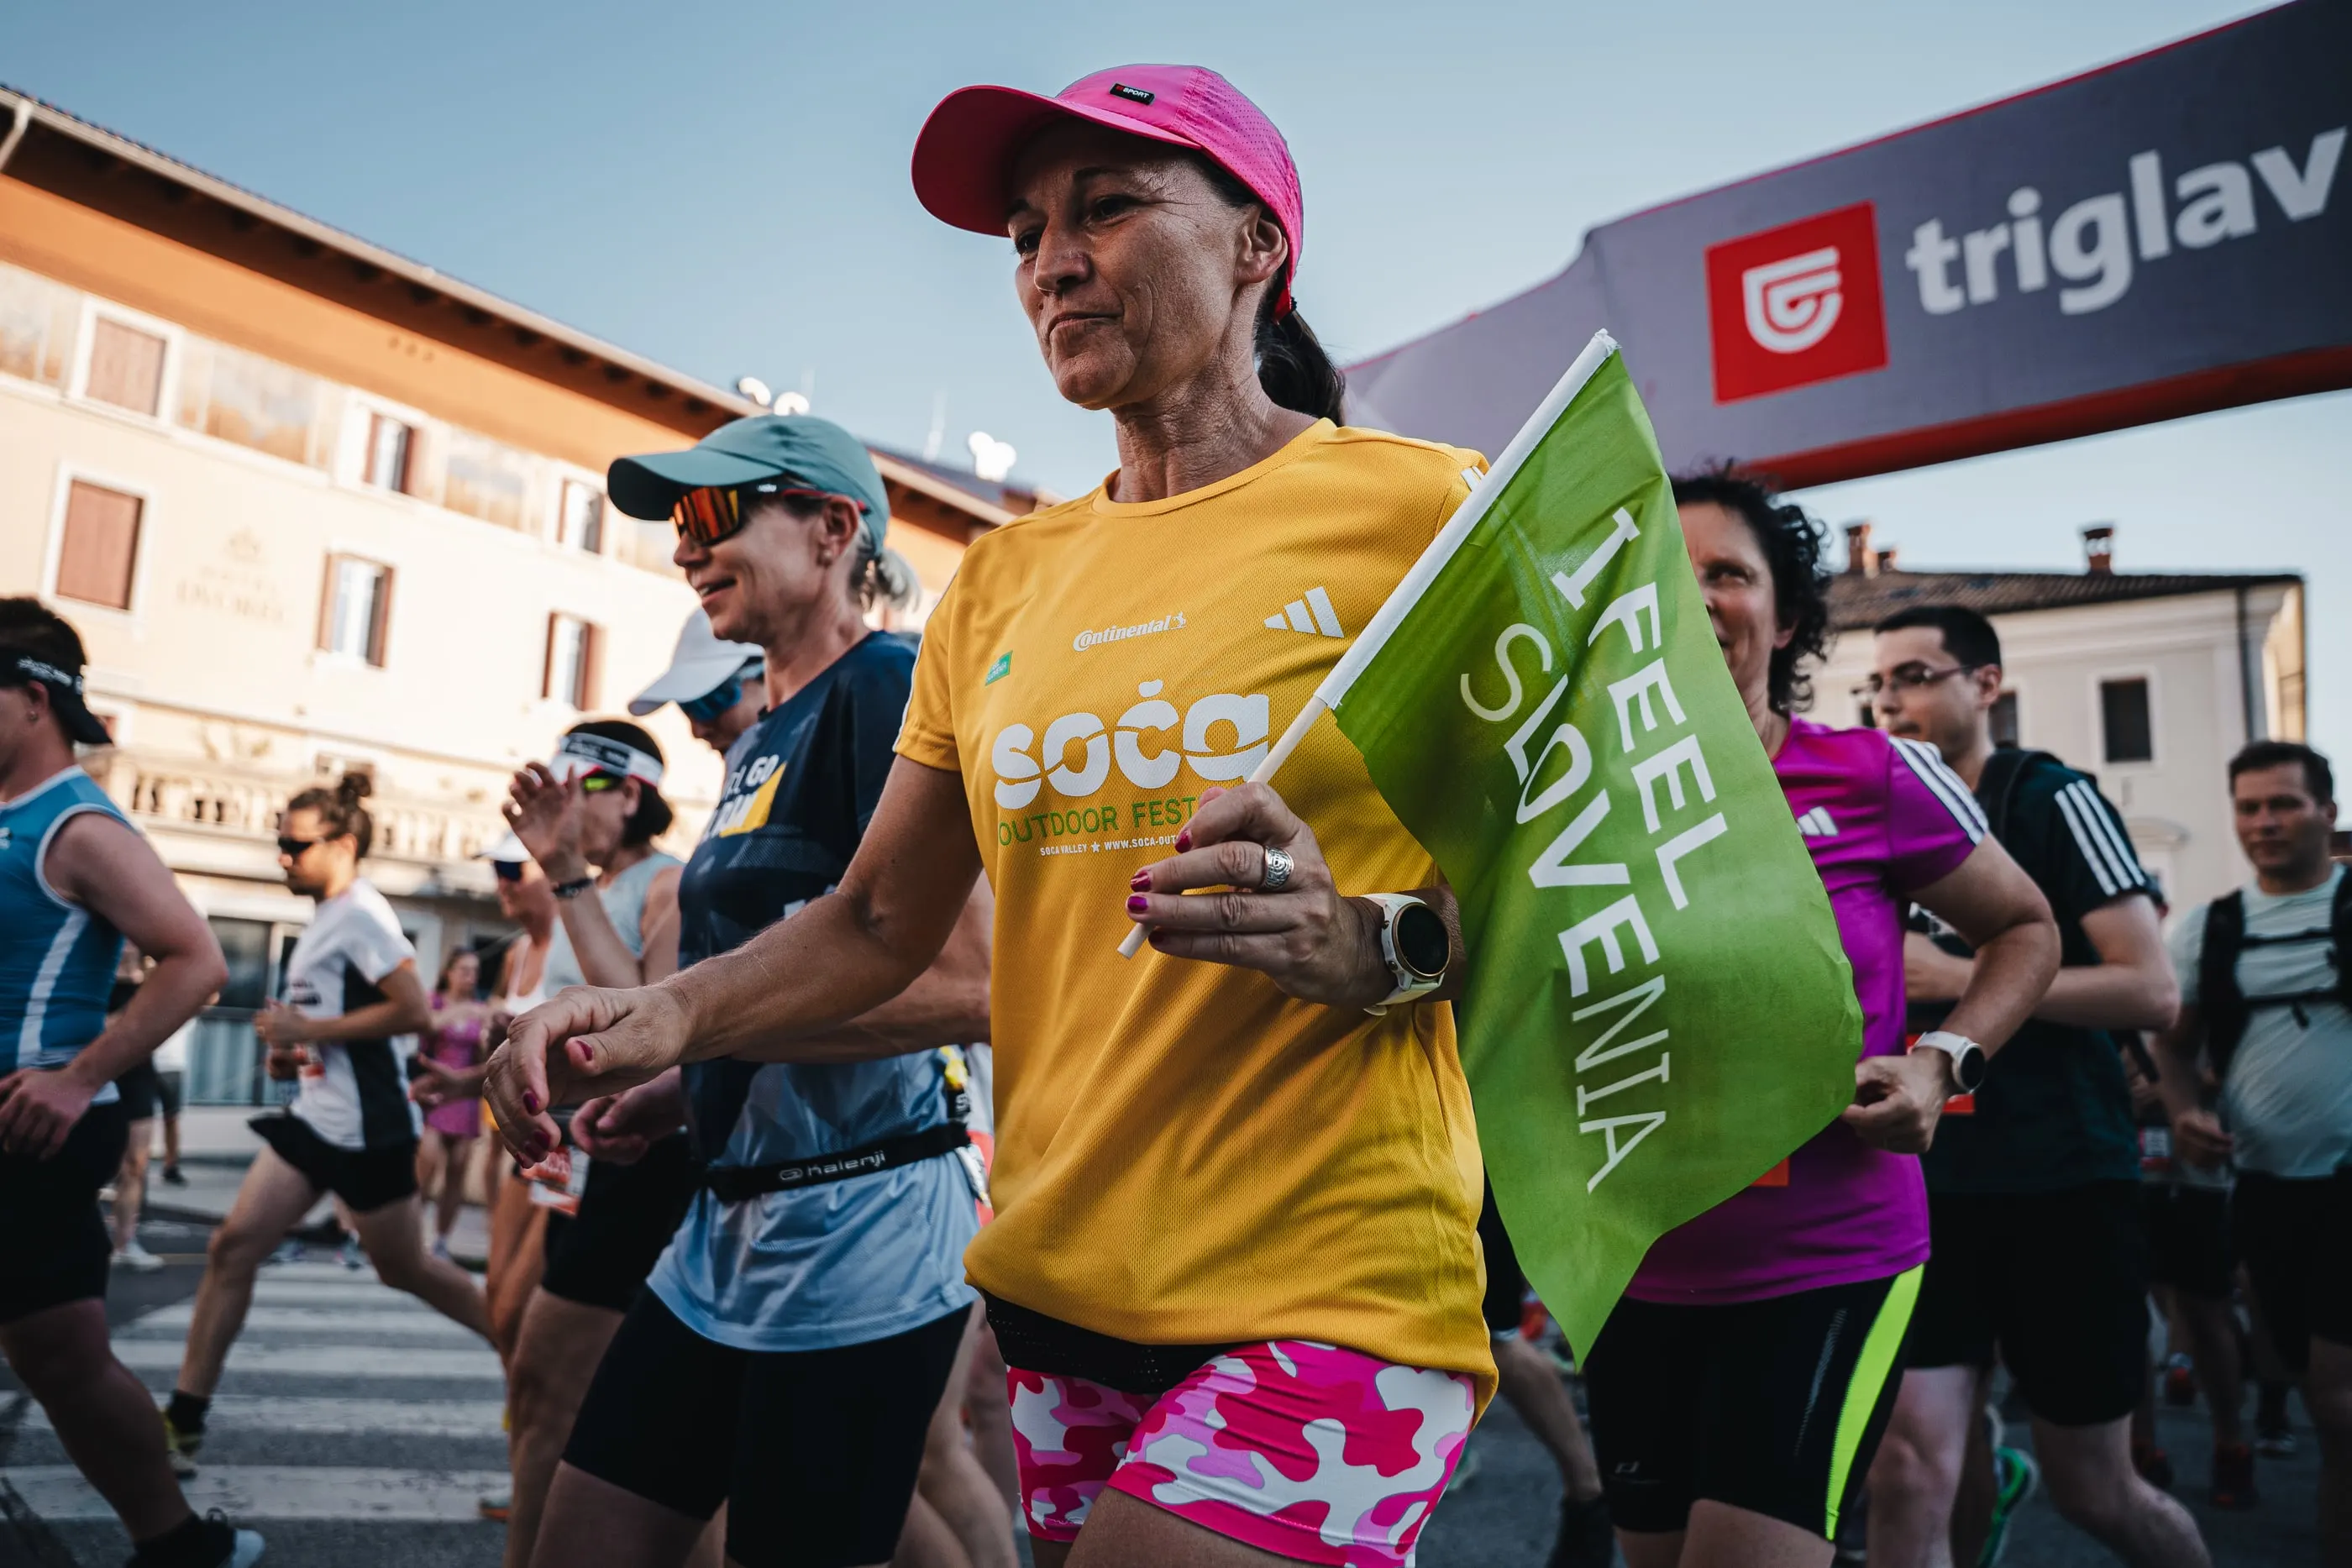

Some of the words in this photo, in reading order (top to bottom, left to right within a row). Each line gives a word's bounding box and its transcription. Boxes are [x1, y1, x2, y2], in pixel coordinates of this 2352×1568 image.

[1122, 87, 1150, 98] SPORT
[1905, 126, 2348, 317] triglav
[1551, 506, 1641, 611] I
[1072, 614, 1172, 653] Continental
[1588, 580, 1729, 911] FEEL
[998, 806, 1120, 847] OUTDOOR
[1040, 846, 1060, 857] SOCA
[1060, 843, 1088, 854] VALLEY
[1104, 835, 1179, 852] WWW.SOCA-OUT
[1460, 622, 1671, 1194] SLOVENIA
